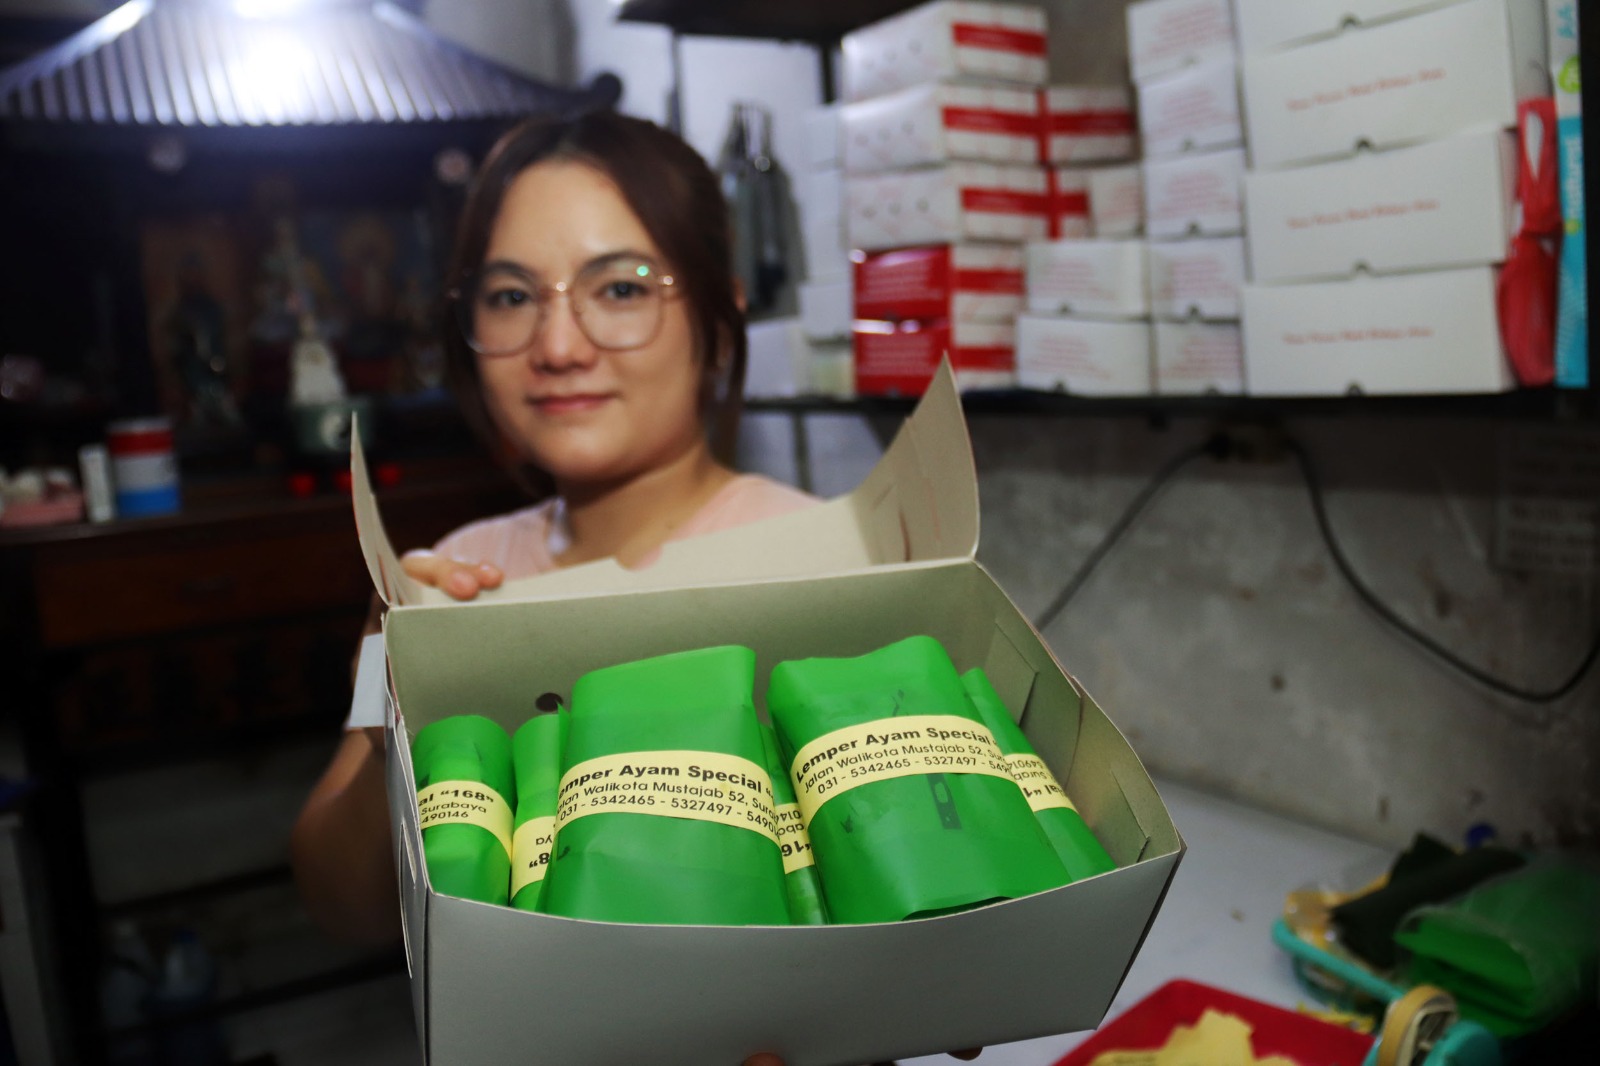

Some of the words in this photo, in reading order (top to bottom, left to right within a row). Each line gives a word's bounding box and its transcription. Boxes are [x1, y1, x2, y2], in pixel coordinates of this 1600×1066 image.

[796, 739, 858, 784] Lemper
[865, 730, 920, 745] Ayam
[926, 727, 991, 745] Special
[804, 766, 834, 793] Jalan
[836, 748, 898, 768] Walikota
[901, 743, 965, 754] Mustajab
[559, 769, 613, 800] emper
[619, 765, 680, 778] Ayam
[687, 765, 762, 793] Special
[817, 777, 838, 794] 031
[850, 758, 911, 778] 5342465
[924, 756, 977, 766] 5327497
[421, 801, 487, 815] Surabaya
[557, 792, 579, 814] alan
[584, 782, 648, 796] Walikota
[653, 782, 723, 798] Mustajab
[560, 803, 578, 821] 031
[590, 795, 655, 807] 5342465
[670, 798, 732, 816] 5327497
